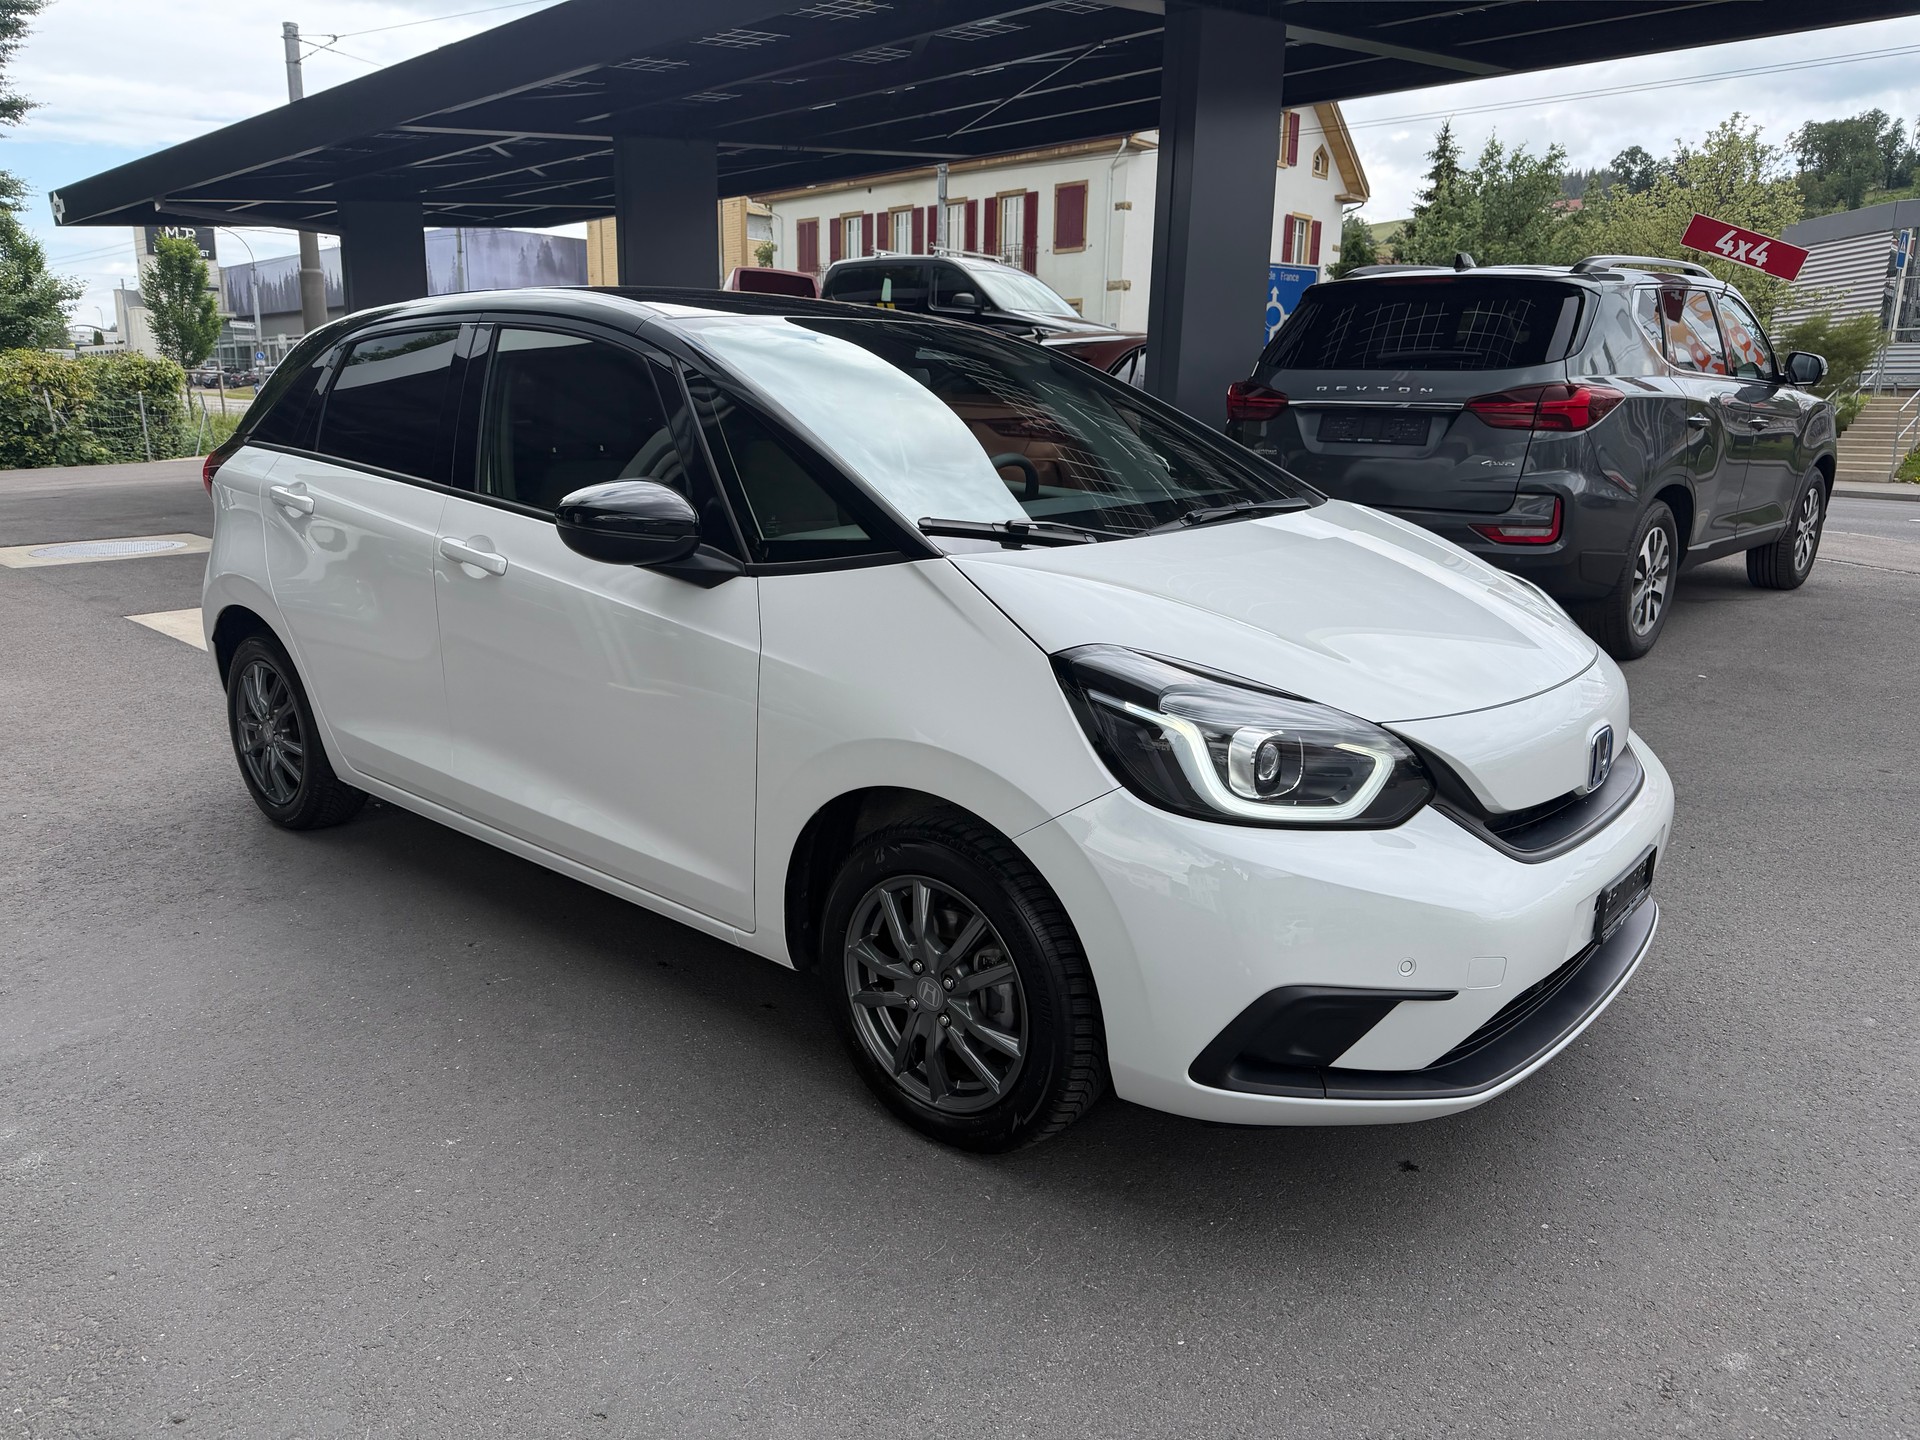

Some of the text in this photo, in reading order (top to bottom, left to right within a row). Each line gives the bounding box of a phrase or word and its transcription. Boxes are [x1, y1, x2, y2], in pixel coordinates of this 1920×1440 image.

[1714, 229, 1771, 267] 4x4
[1280, 271, 1300, 282] France
[1316, 385, 1434, 394] REXTON
